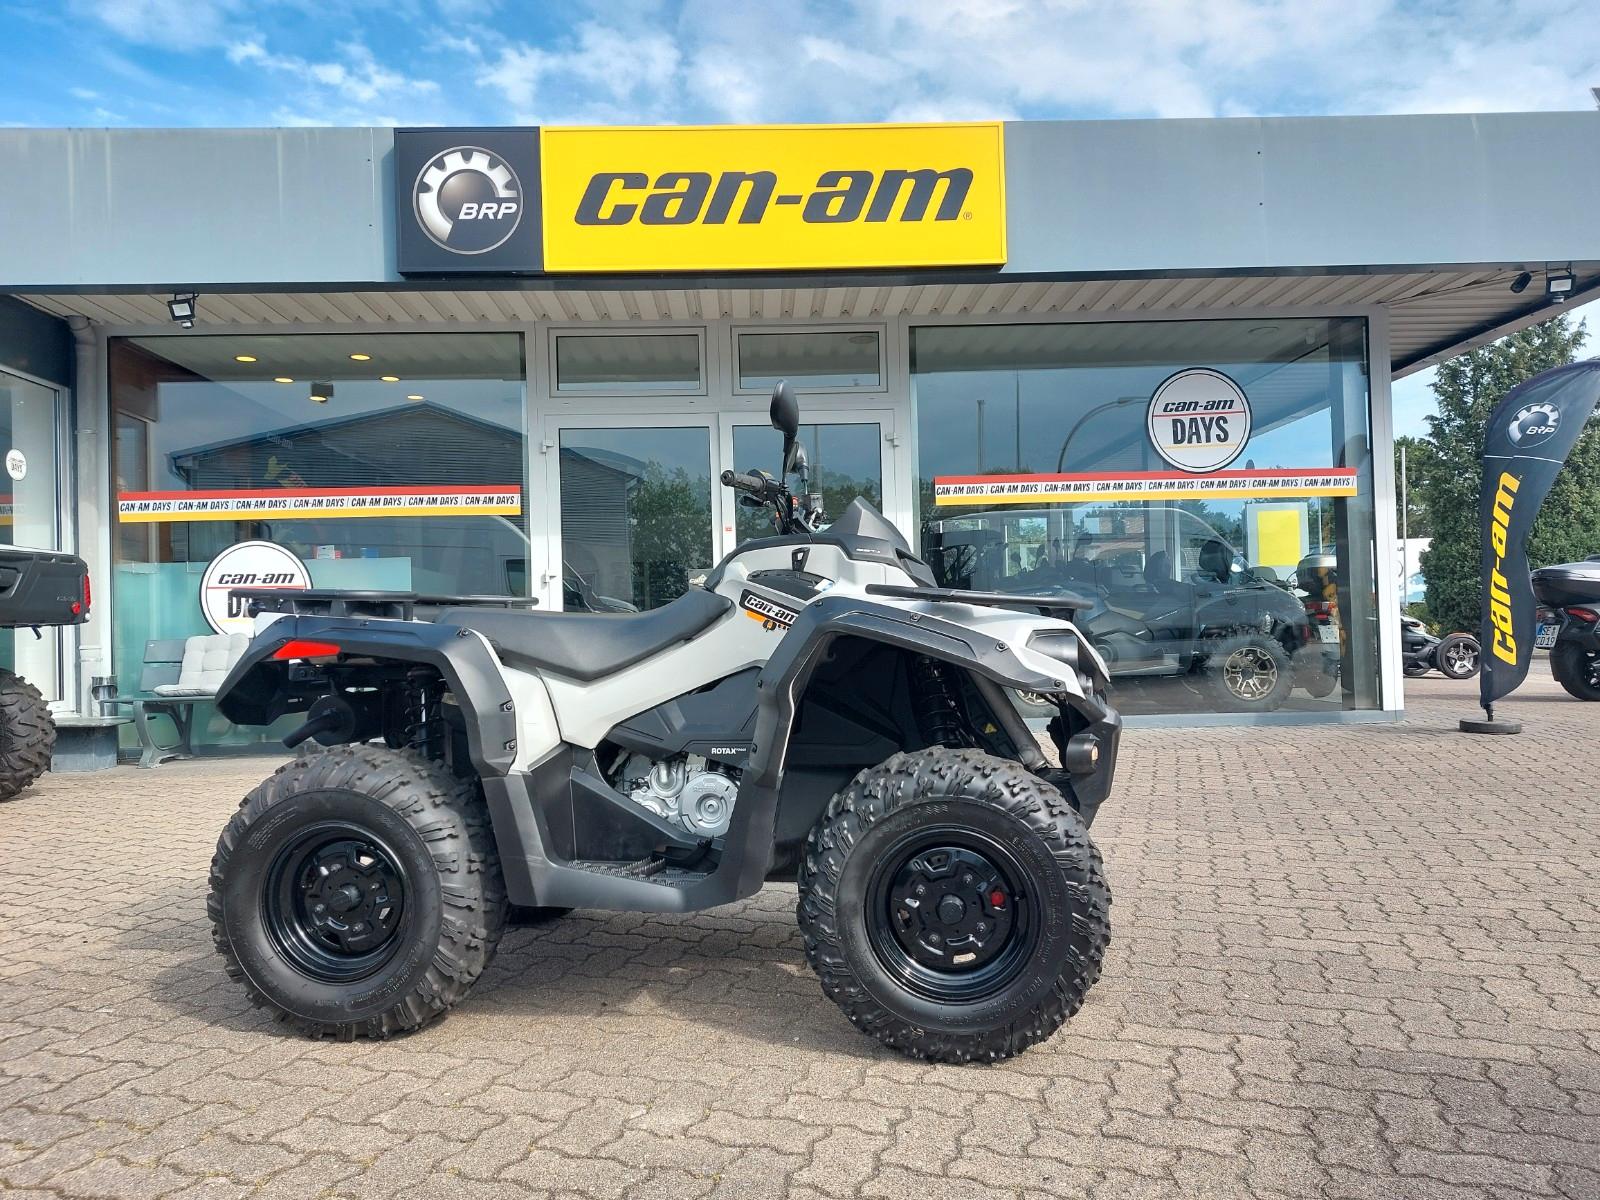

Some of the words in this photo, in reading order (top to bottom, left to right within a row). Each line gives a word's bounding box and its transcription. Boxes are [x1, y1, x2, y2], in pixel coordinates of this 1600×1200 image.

[574, 167, 974, 225] can-am
[458, 202, 518, 220] BRP
[1163, 399, 1234, 412] can-am
[1172, 416, 1229, 444] DAYS
[936, 486, 964, 496] CAN-AM
[966, 485, 984, 495] DAYS
[990, 484, 1018, 494] CAN-AM
[1020, 484, 1038, 493] DAYS
[1044, 483, 1071, 492] CAN-AM
[1073, 482, 1090, 492] DAYS
[1096, 482, 1123, 491] CAN-AM
[1125, 481, 1142, 491] DAYS
[1148, 481, 1176, 490] CAN-AM
[1177, 480, 1194, 489] DAYS
[1200, 480, 1227, 489] CAN-AM
[1229, 479, 1246, 488] DAYS
[1252, 479, 1280, 488] CAN-AM
[1281, 478, 1299, 487] DAYS
[1304, 478, 1332, 487] CAN-AM
[1333, 478, 1350, 487] DAYS
[120, 502, 150, 512] CAN-AM
[152, 502, 171, 511] DAYS
[178, 501, 208, 511] CAN-AM
[210, 501, 229, 510] DAYS
[235, 501, 265, 510] CAN-AM
[267, 500, 287, 509] DAYS
[293, 499, 323, 508] CAN-AM
[326, 498, 344, 507] DAYS
[351, 497, 381, 507] CAN-AM
[383, 497, 402, 506] DAYS
[408, 497, 438, 506] CAN-AM
[440, 496, 458, 505] DAYS
[465, 496, 494, 505] CAN-AM
[496, 496, 514, 504] DAYS
[1491, 472, 1521, 666] can-am
[218, 573, 295, 585] can-am
[711, 747, 737, 755] ROTAX
